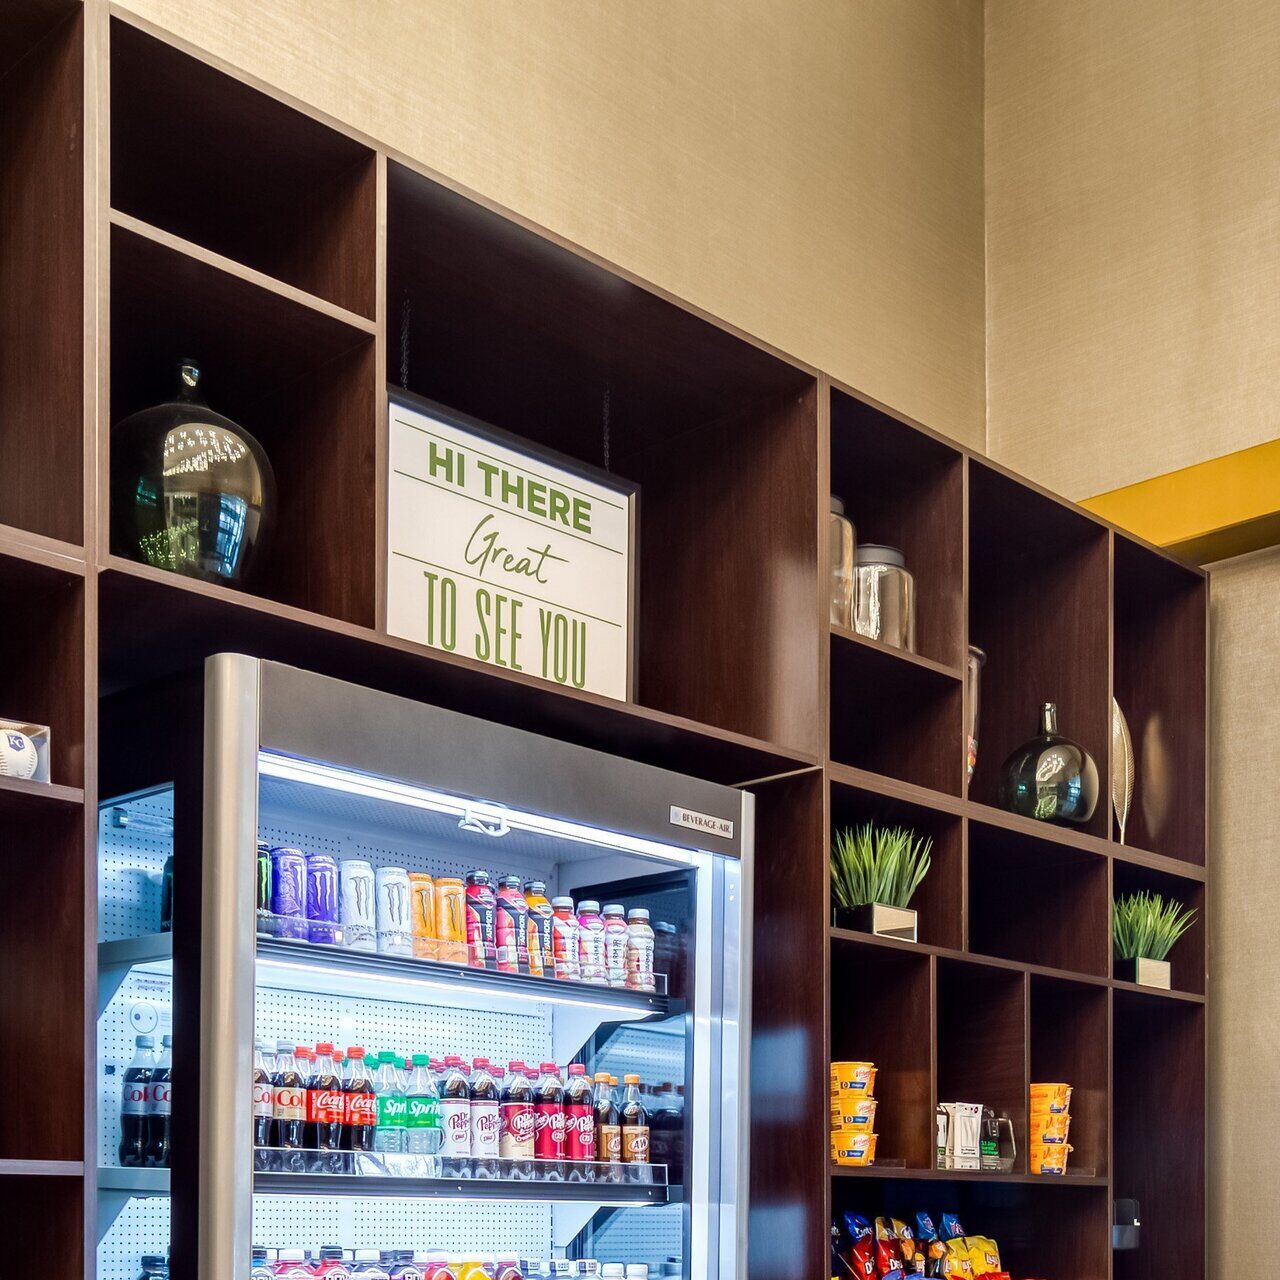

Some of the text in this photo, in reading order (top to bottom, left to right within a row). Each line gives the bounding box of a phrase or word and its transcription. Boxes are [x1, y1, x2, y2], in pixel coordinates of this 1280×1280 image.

[428, 441, 592, 534] HI THERE
[464, 513, 570, 584] Great
[424, 571, 587, 689] TO SEE YOU
[9, 734, 23, 748] KC
[682, 812, 731, 834] BEVERAGE-AIR
